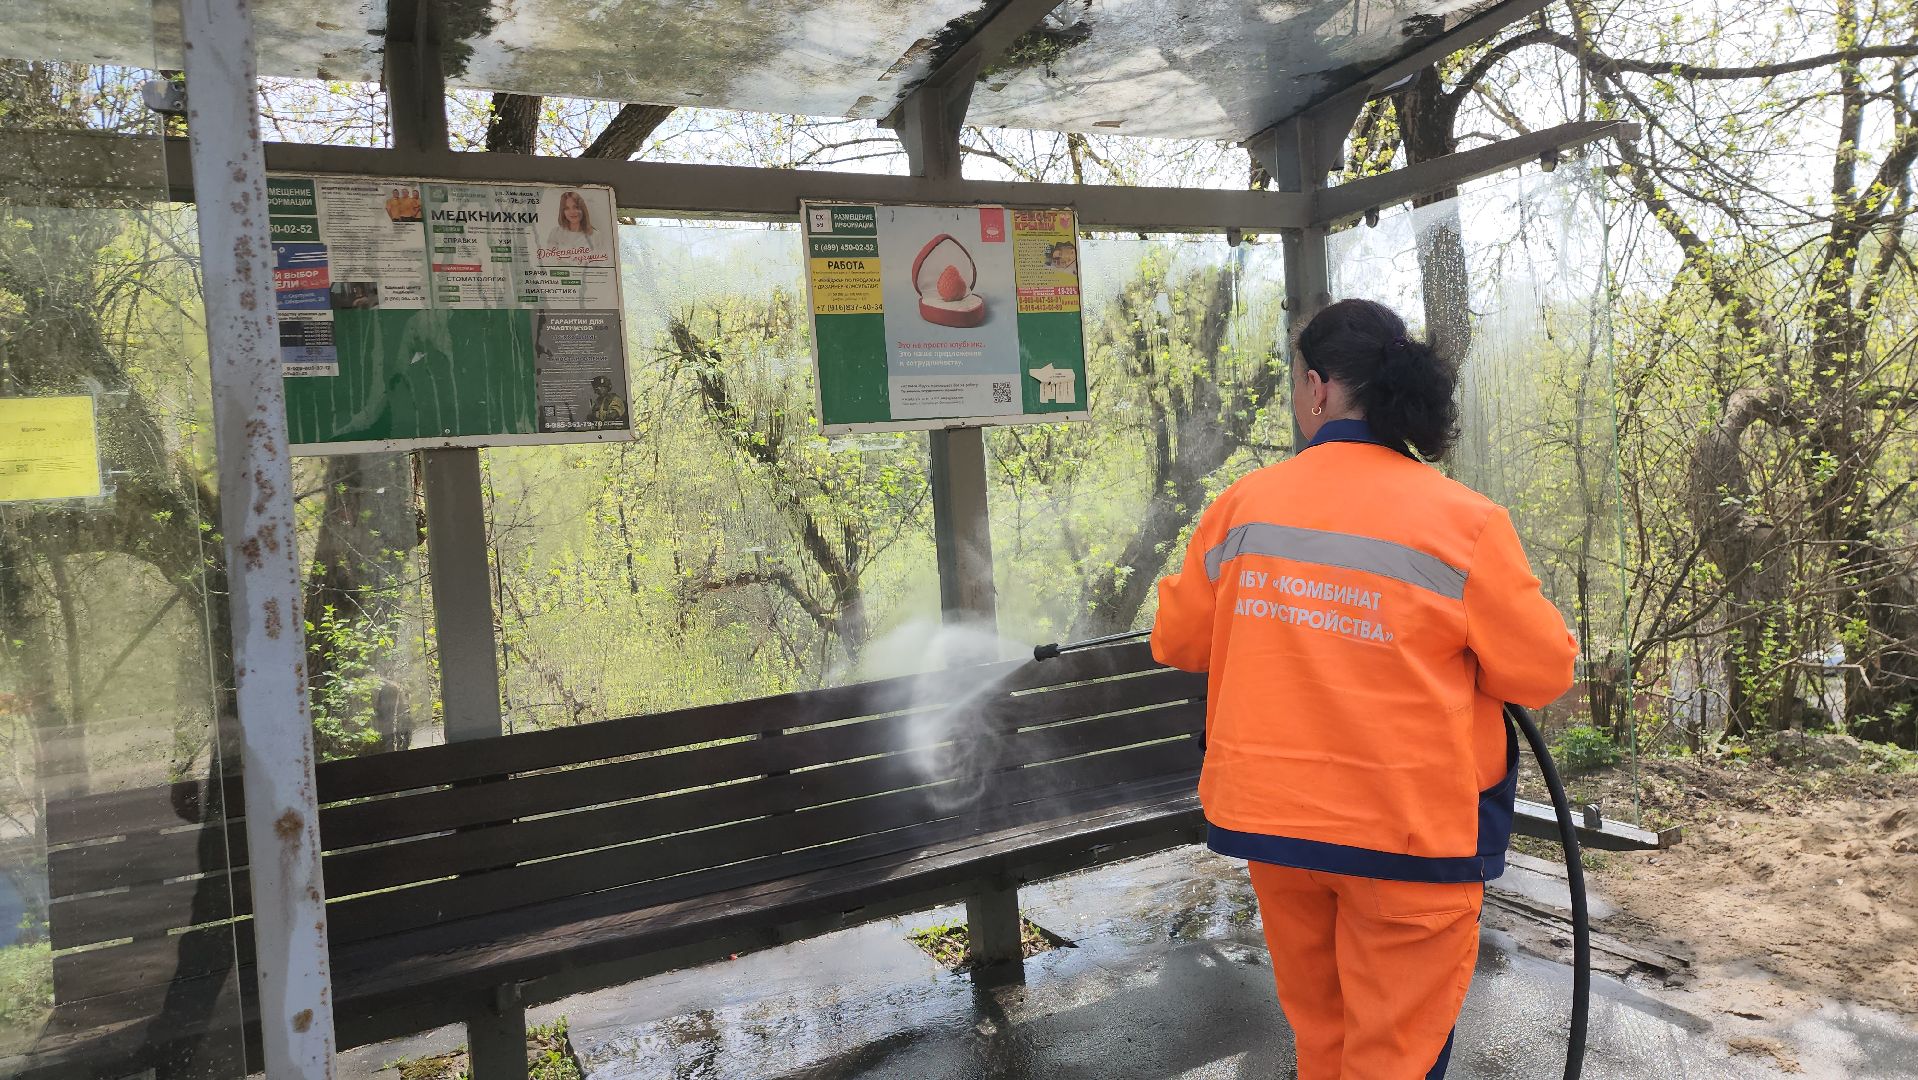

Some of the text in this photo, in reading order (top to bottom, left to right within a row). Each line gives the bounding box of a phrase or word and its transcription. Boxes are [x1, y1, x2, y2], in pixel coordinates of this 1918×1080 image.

[431, 210, 539, 223] МЕДКНИЖКИ
[1013, 211, 1057, 222] РЕМОНТ
[1014, 221, 1056, 231] КРЫШИ
[820, 243, 839, 252] (499)
[827, 260, 865, 270] РАБОТА
[284, 270, 319, 279] ВЫБОР
[897, 341, 911, 349] Это
[1272, 575, 1382, 611] «КОМБИНАТ
[1234, 598, 1394, 642] АГОУСТРОЙСТВА»
